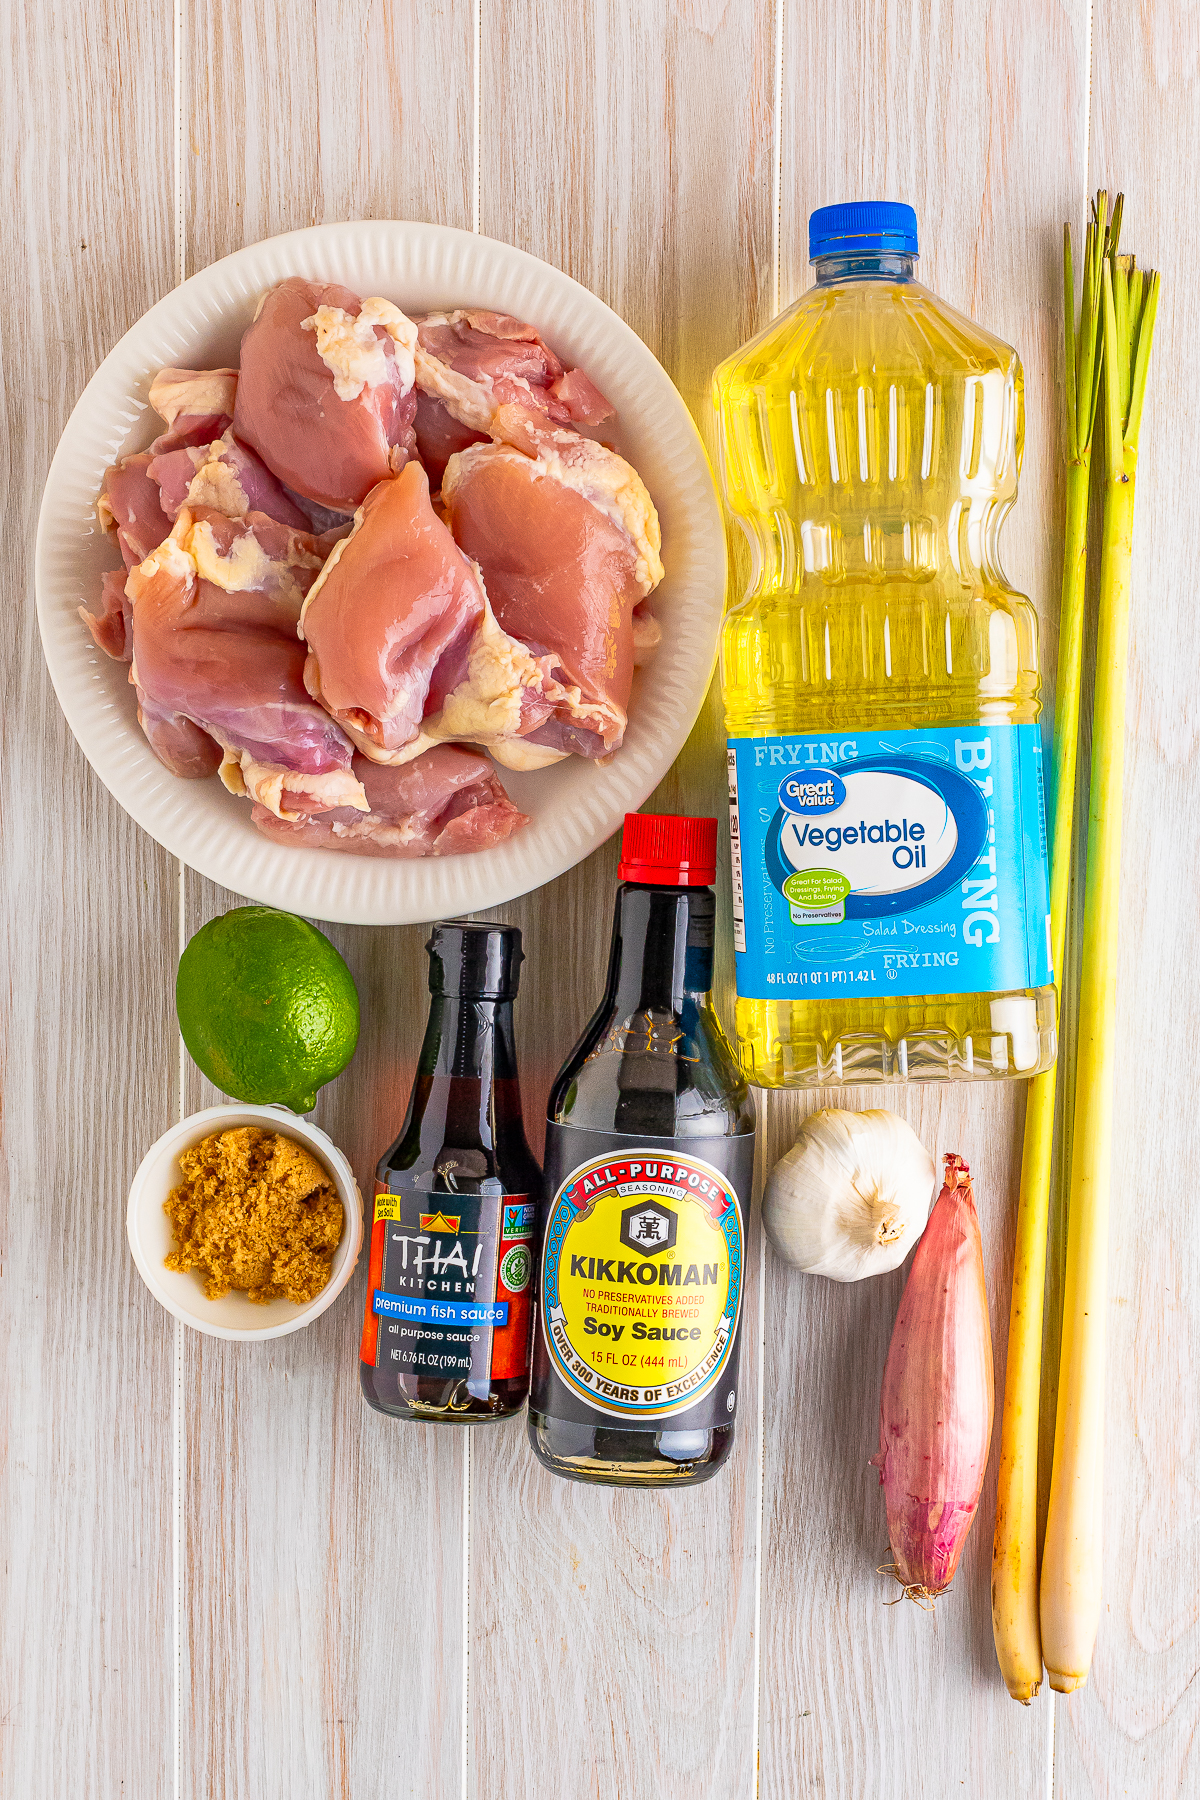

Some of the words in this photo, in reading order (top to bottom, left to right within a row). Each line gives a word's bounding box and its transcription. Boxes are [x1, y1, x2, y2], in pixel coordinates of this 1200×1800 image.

[754, 741, 859, 767] FRYING
[786, 780, 834, 797] Great
[798, 795, 835, 807] Value
[792, 819, 925, 852] Vegetable
[955, 737, 1000, 948] BING
[892, 845, 926, 869] Oil
[789, 886, 823, 894] Dressings,
[813, 893, 837, 901] Baking
[802, 911, 842, 919] Preservatives
[862, 921, 898, 936] Salad
[901, 919, 957, 937] Dressing
[765, 937, 775, 955] No
[883, 951, 960, 968] FRYING
[766, 973, 776, 984] 48
[776, 973, 787, 984] FL
[787, 972, 799, 984] OZ
[799, 972, 808, 985] (1
[810, 972, 824, 984] QT
[824, 972, 829, 982] 1
[831, 970, 847, 983] PT)
[849, 970, 869, 982] 1.42
[870, 970, 877, 981] L
[620, 1184, 684, 1197] SEASONING
[386, 1196, 398, 1207] with
[391, 1234, 484, 1279] THAI
[570, 1254, 718, 1286] KIKKOMAN
[399, 1276, 475, 1293] KITCHEN
[582, 1288, 596, 1299] NO
[597, 1290, 673, 1306] PRESERVATIVES
[675, 1295, 705, 1305] ADDED
[375, 1297, 427, 1316] premium
[430, 1304, 456, 1319] fish
[460, 1309, 504, 1320] sauce
[585, 1302, 659, 1318] TRADITIONALLY
[661, 1309, 700, 1319] BREWED
[388, 1324, 399, 1334] all
[400, 1327, 444, 1340] purpose
[446, 1332, 480, 1342] sauce
[583, 1316, 626, 1342] Soy
[631, 1321, 702, 1342] Sauce
[390, 1348, 402, 1361] NET
[402, 1350, 418, 1363] 6.76
[418, 1352, 427, 1365] FL
[427, 1354, 439, 1366] OZ
[439, 1355, 457, 1370] (199
[457, 1356, 473, 1371] mL)
[552, 1324, 574, 1363] OVER
[571, 1359, 594, 1384] 300
[595, 1376, 639, 1402] YEARS
[643, 1388, 662, 1402] OF
[665, 1334, 728, 1399] EXCELLENCE
[590, 1350, 603, 1363] 15
[606, 1353, 618, 1365] FL
[622, 1354, 638, 1367] OZ
[640, 1355, 665, 1369] (444
[668, 1355, 688, 1369] mL)
